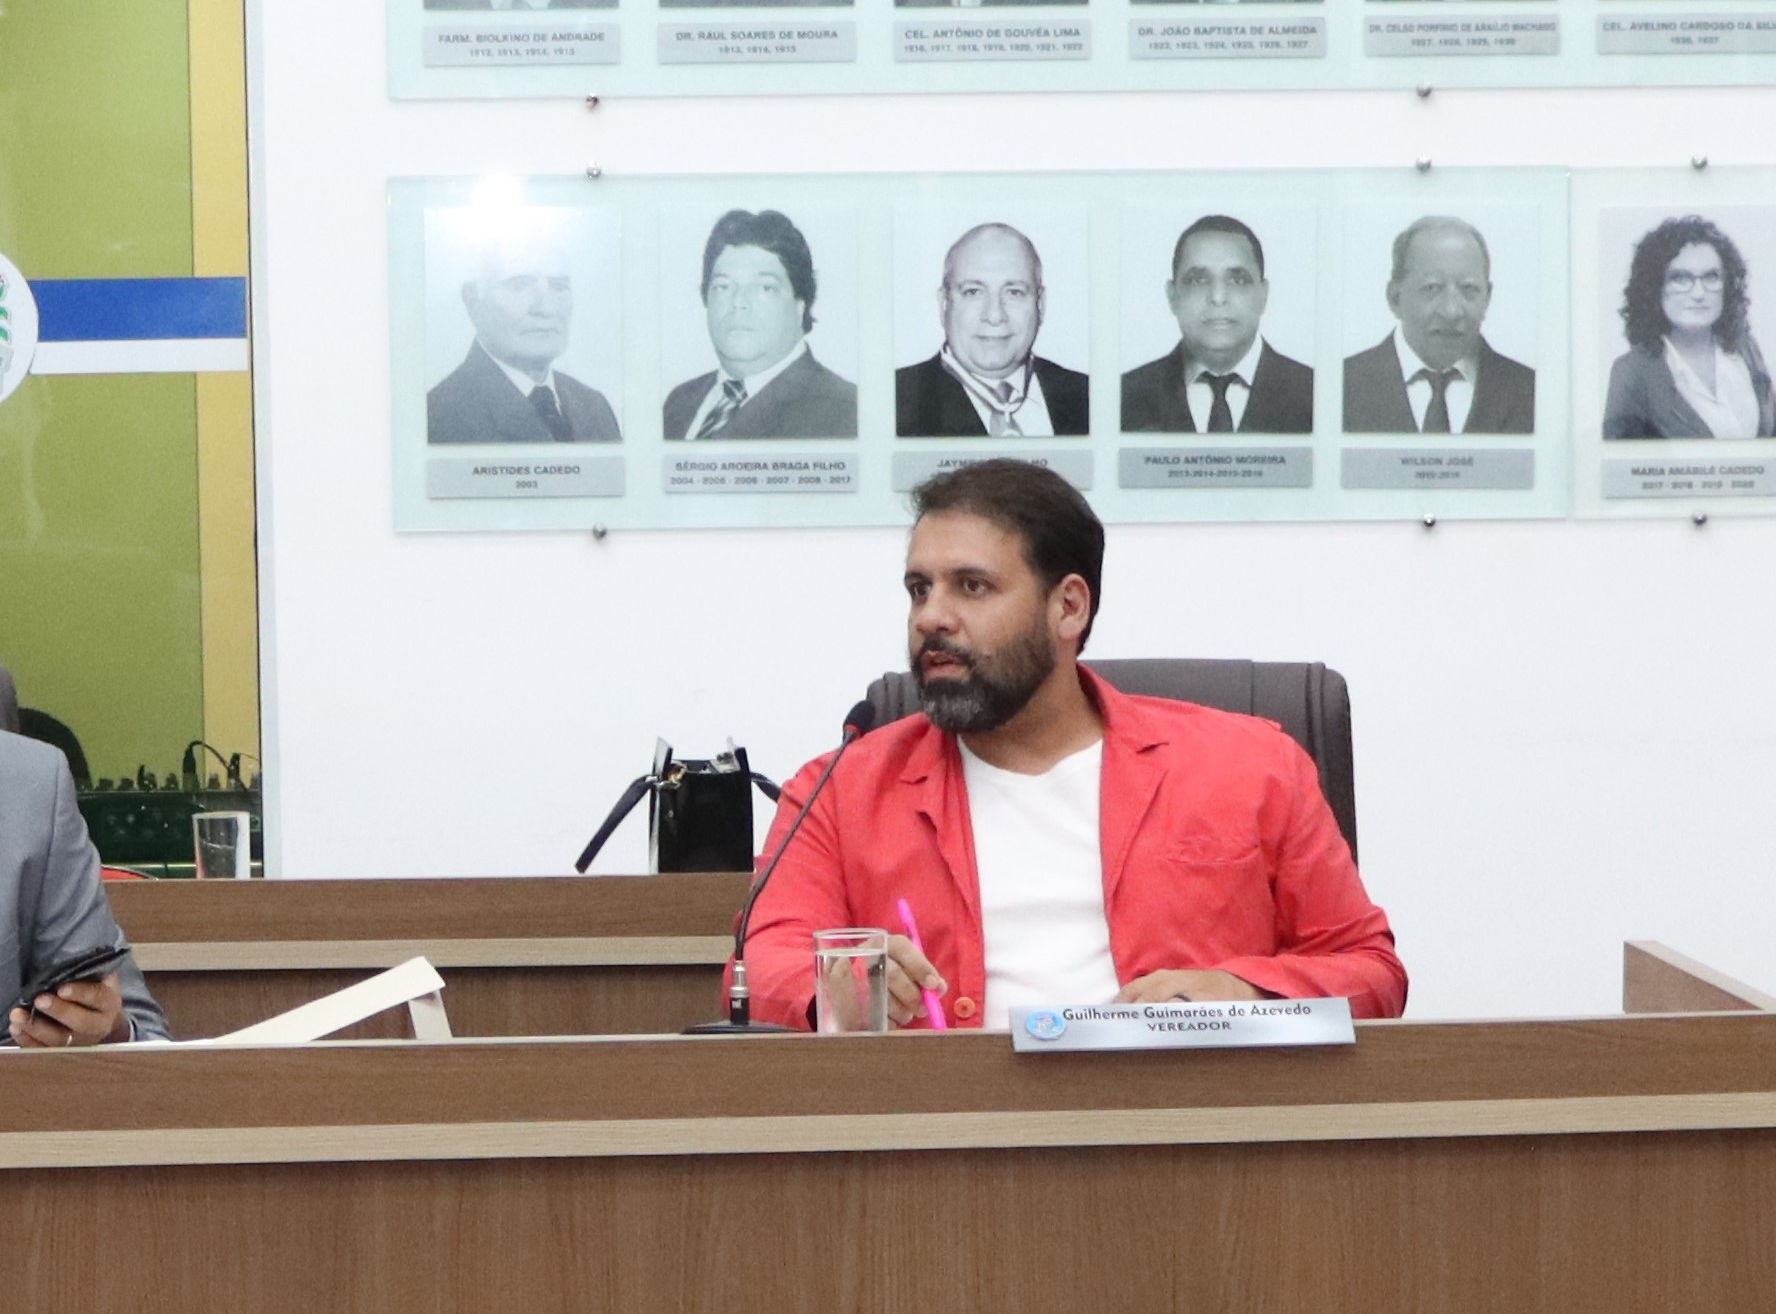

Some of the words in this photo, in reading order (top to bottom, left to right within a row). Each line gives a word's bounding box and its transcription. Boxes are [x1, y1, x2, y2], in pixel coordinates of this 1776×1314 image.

[933, 27, 984, 38] ANTÔNIO
[986, 29, 1001, 38] DE
[1054, 28, 1081, 37] LIMA
[1250, 26, 1264, 35] DE
[1268, 26, 1318, 34] ALMEIDA
[532, 33, 548, 42] DE
[551, 32, 605, 41] ANDRADE
[698, 32, 727, 40] RAUL
[731, 31, 776, 40] SOARES
[779, 31, 793, 39] DE
[797, 31, 839, 39] MOURA
[1235, 456, 1287, 464] MOREIRA
[472, 466, 531, 475] ARISTIDES
[675, 461, 718, 471] SÉRGIO
[721, 462, 768, 471] AROEIRA
[771, 462, 810, 470] BRAGA
[813, 462, 846, 470] FILHO
[1631, 468, 1665, 476] MARIA
[1063, 1008, 1140, 1021] Guilherme
[1143, 1006, 1224, 1019] Guimarães
[1228, 1005, 1245, 1017] de
[1250, 1003, 1312, 1017] Azevedo
[1147, 1021, 1232, 1032] VEREADOR
